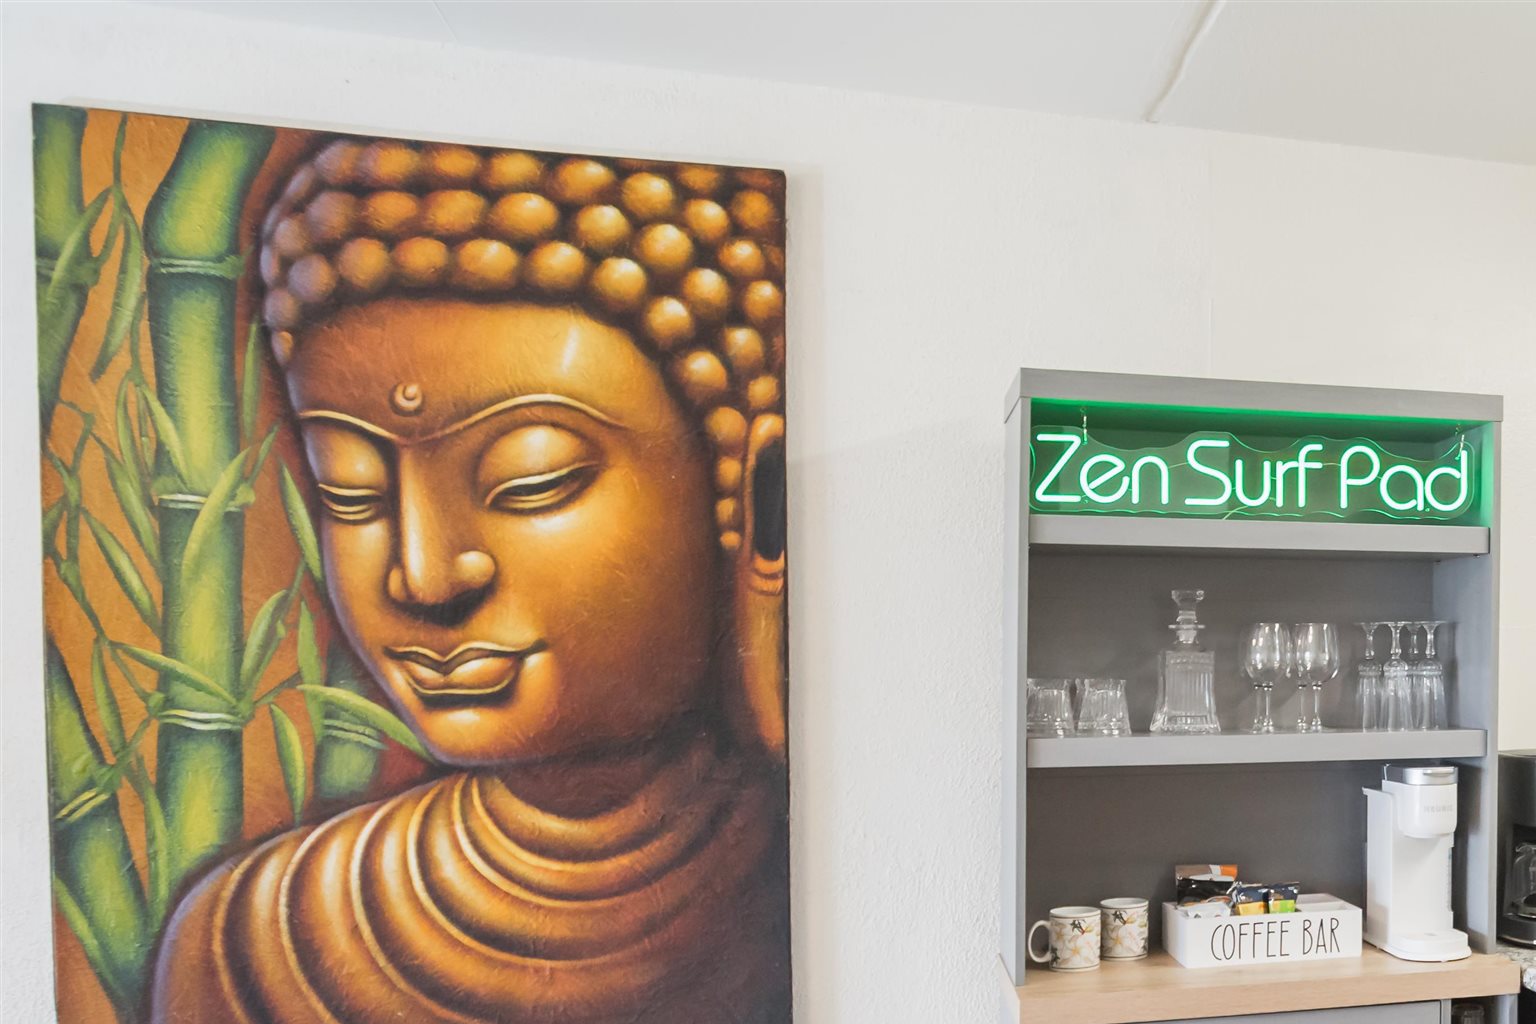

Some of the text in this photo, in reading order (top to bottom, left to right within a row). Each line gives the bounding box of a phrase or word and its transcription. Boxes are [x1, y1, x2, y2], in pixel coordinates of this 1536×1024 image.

[1034, 432, 1469, 512] Zen Surf Pad
[1210, 917, 1341, 961] COFFEE BAR
